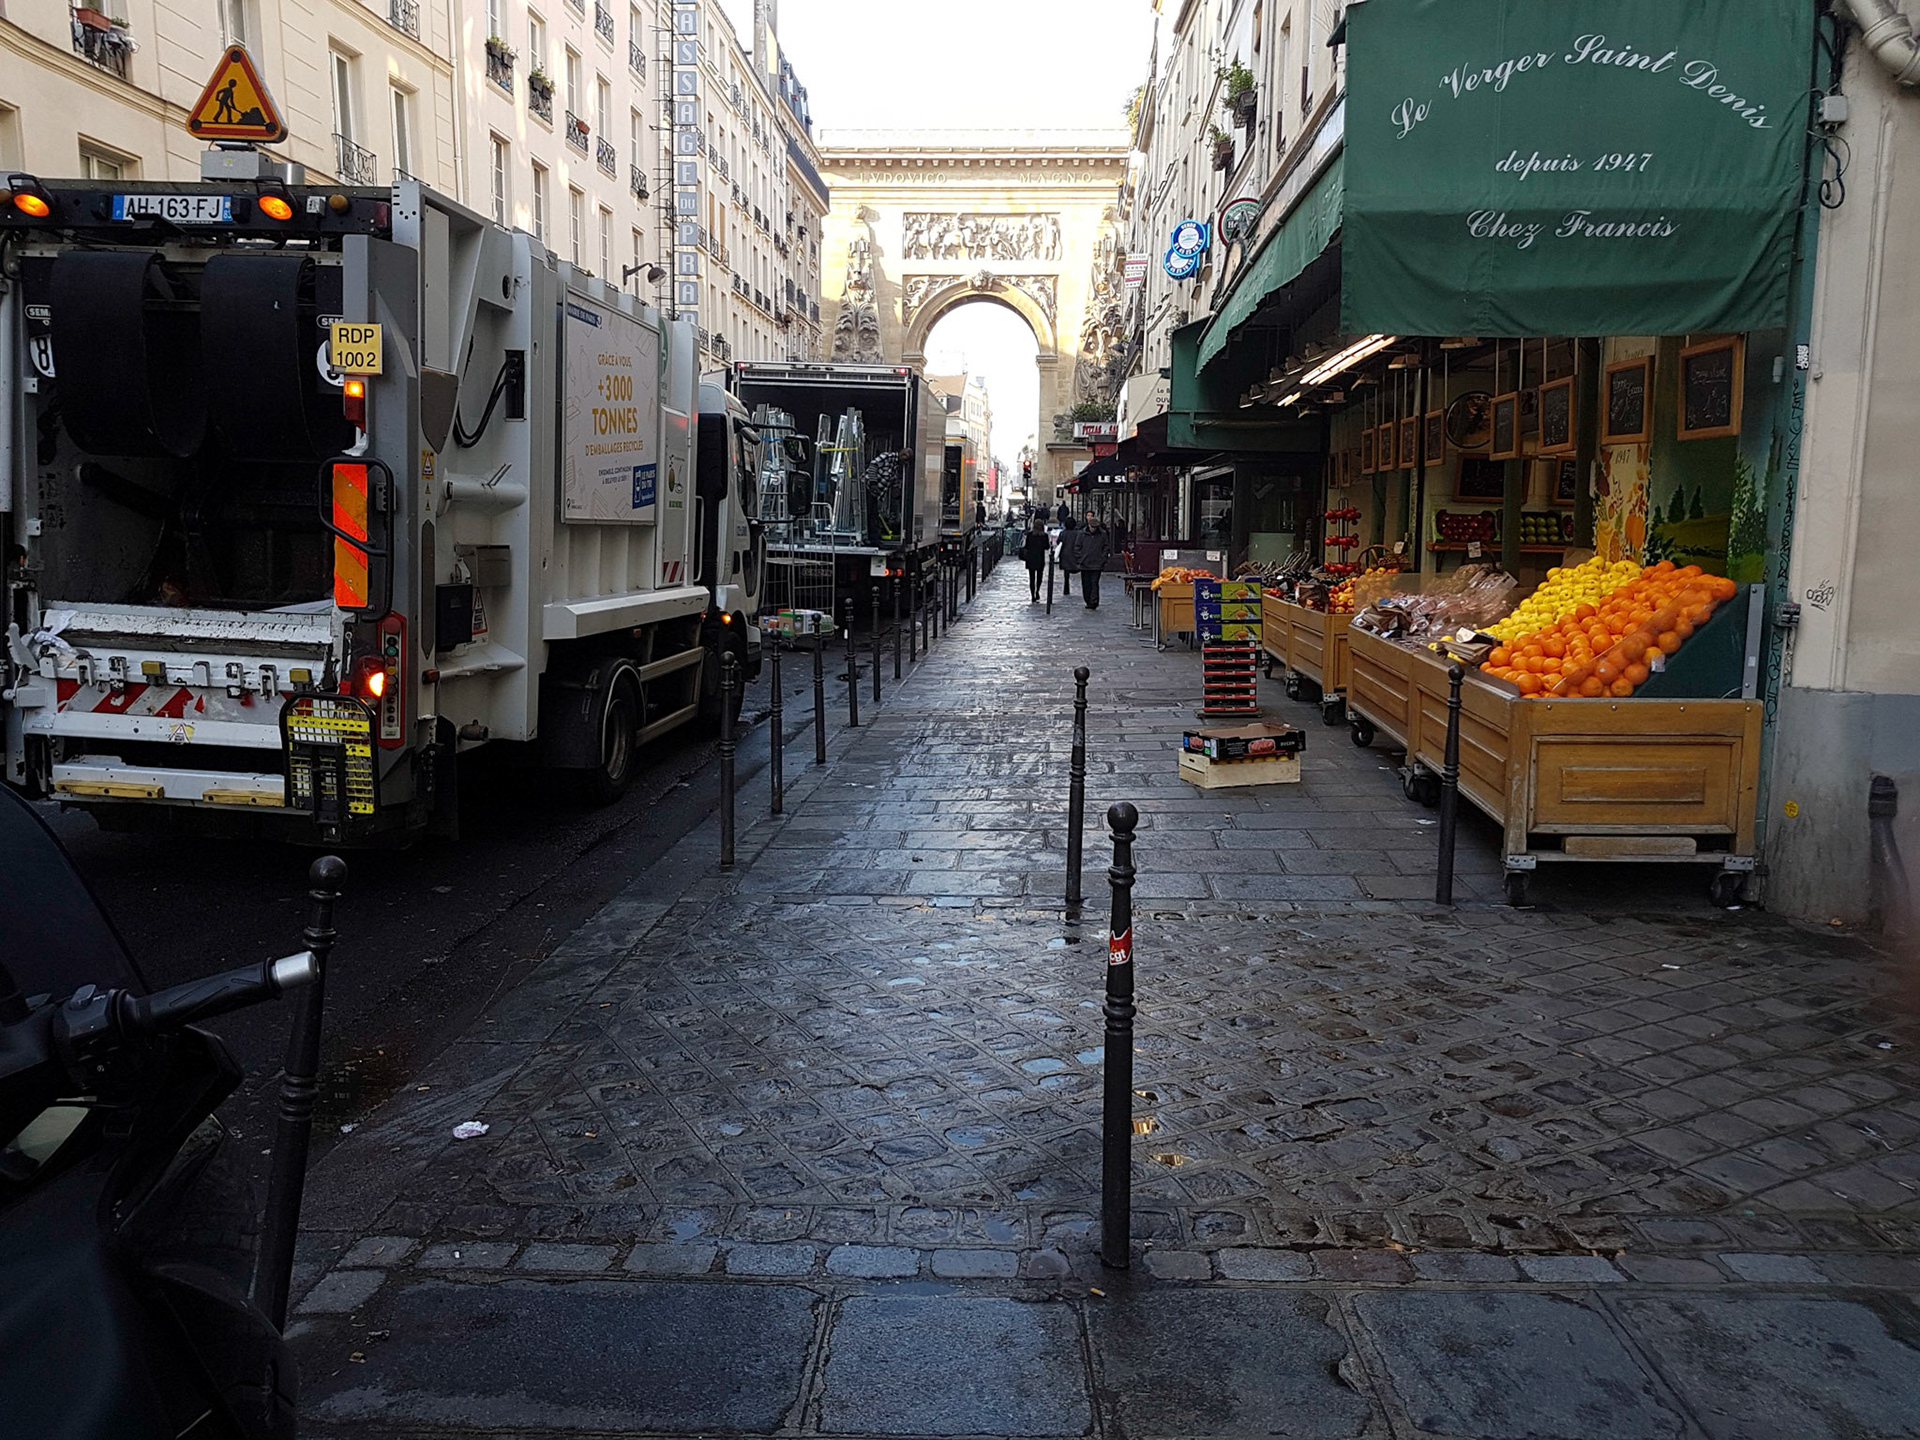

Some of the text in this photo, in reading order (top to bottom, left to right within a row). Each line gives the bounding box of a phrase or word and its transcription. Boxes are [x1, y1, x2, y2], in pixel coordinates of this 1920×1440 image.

[1390, 34, 1772, 140] Le Verger Saint Denis
[1495, 150, 1654, 181] depuis 1947
[1019, 171, 1094, 185] MAGNO
[126, 197, 220, 219] AH-163-FJ
[680, 198, 696, 211] DU
[1465, 209, 1681, 250] Chez Francis
[29, 307, 51, 317] SEM
[338, 327, 375, 344] RDP
[336, 350, 377, 368] 1002
[597, 351, 615, 367] GRÂCE
[1156, 404, 1164, 414] 7
[591, 406, 638, 436] TONNES
[585, 441, 623, 457] D'EMBALLAGES
[1097, 475, 1111, 483] LE
[1109, 948, 1127, 962] cgt
